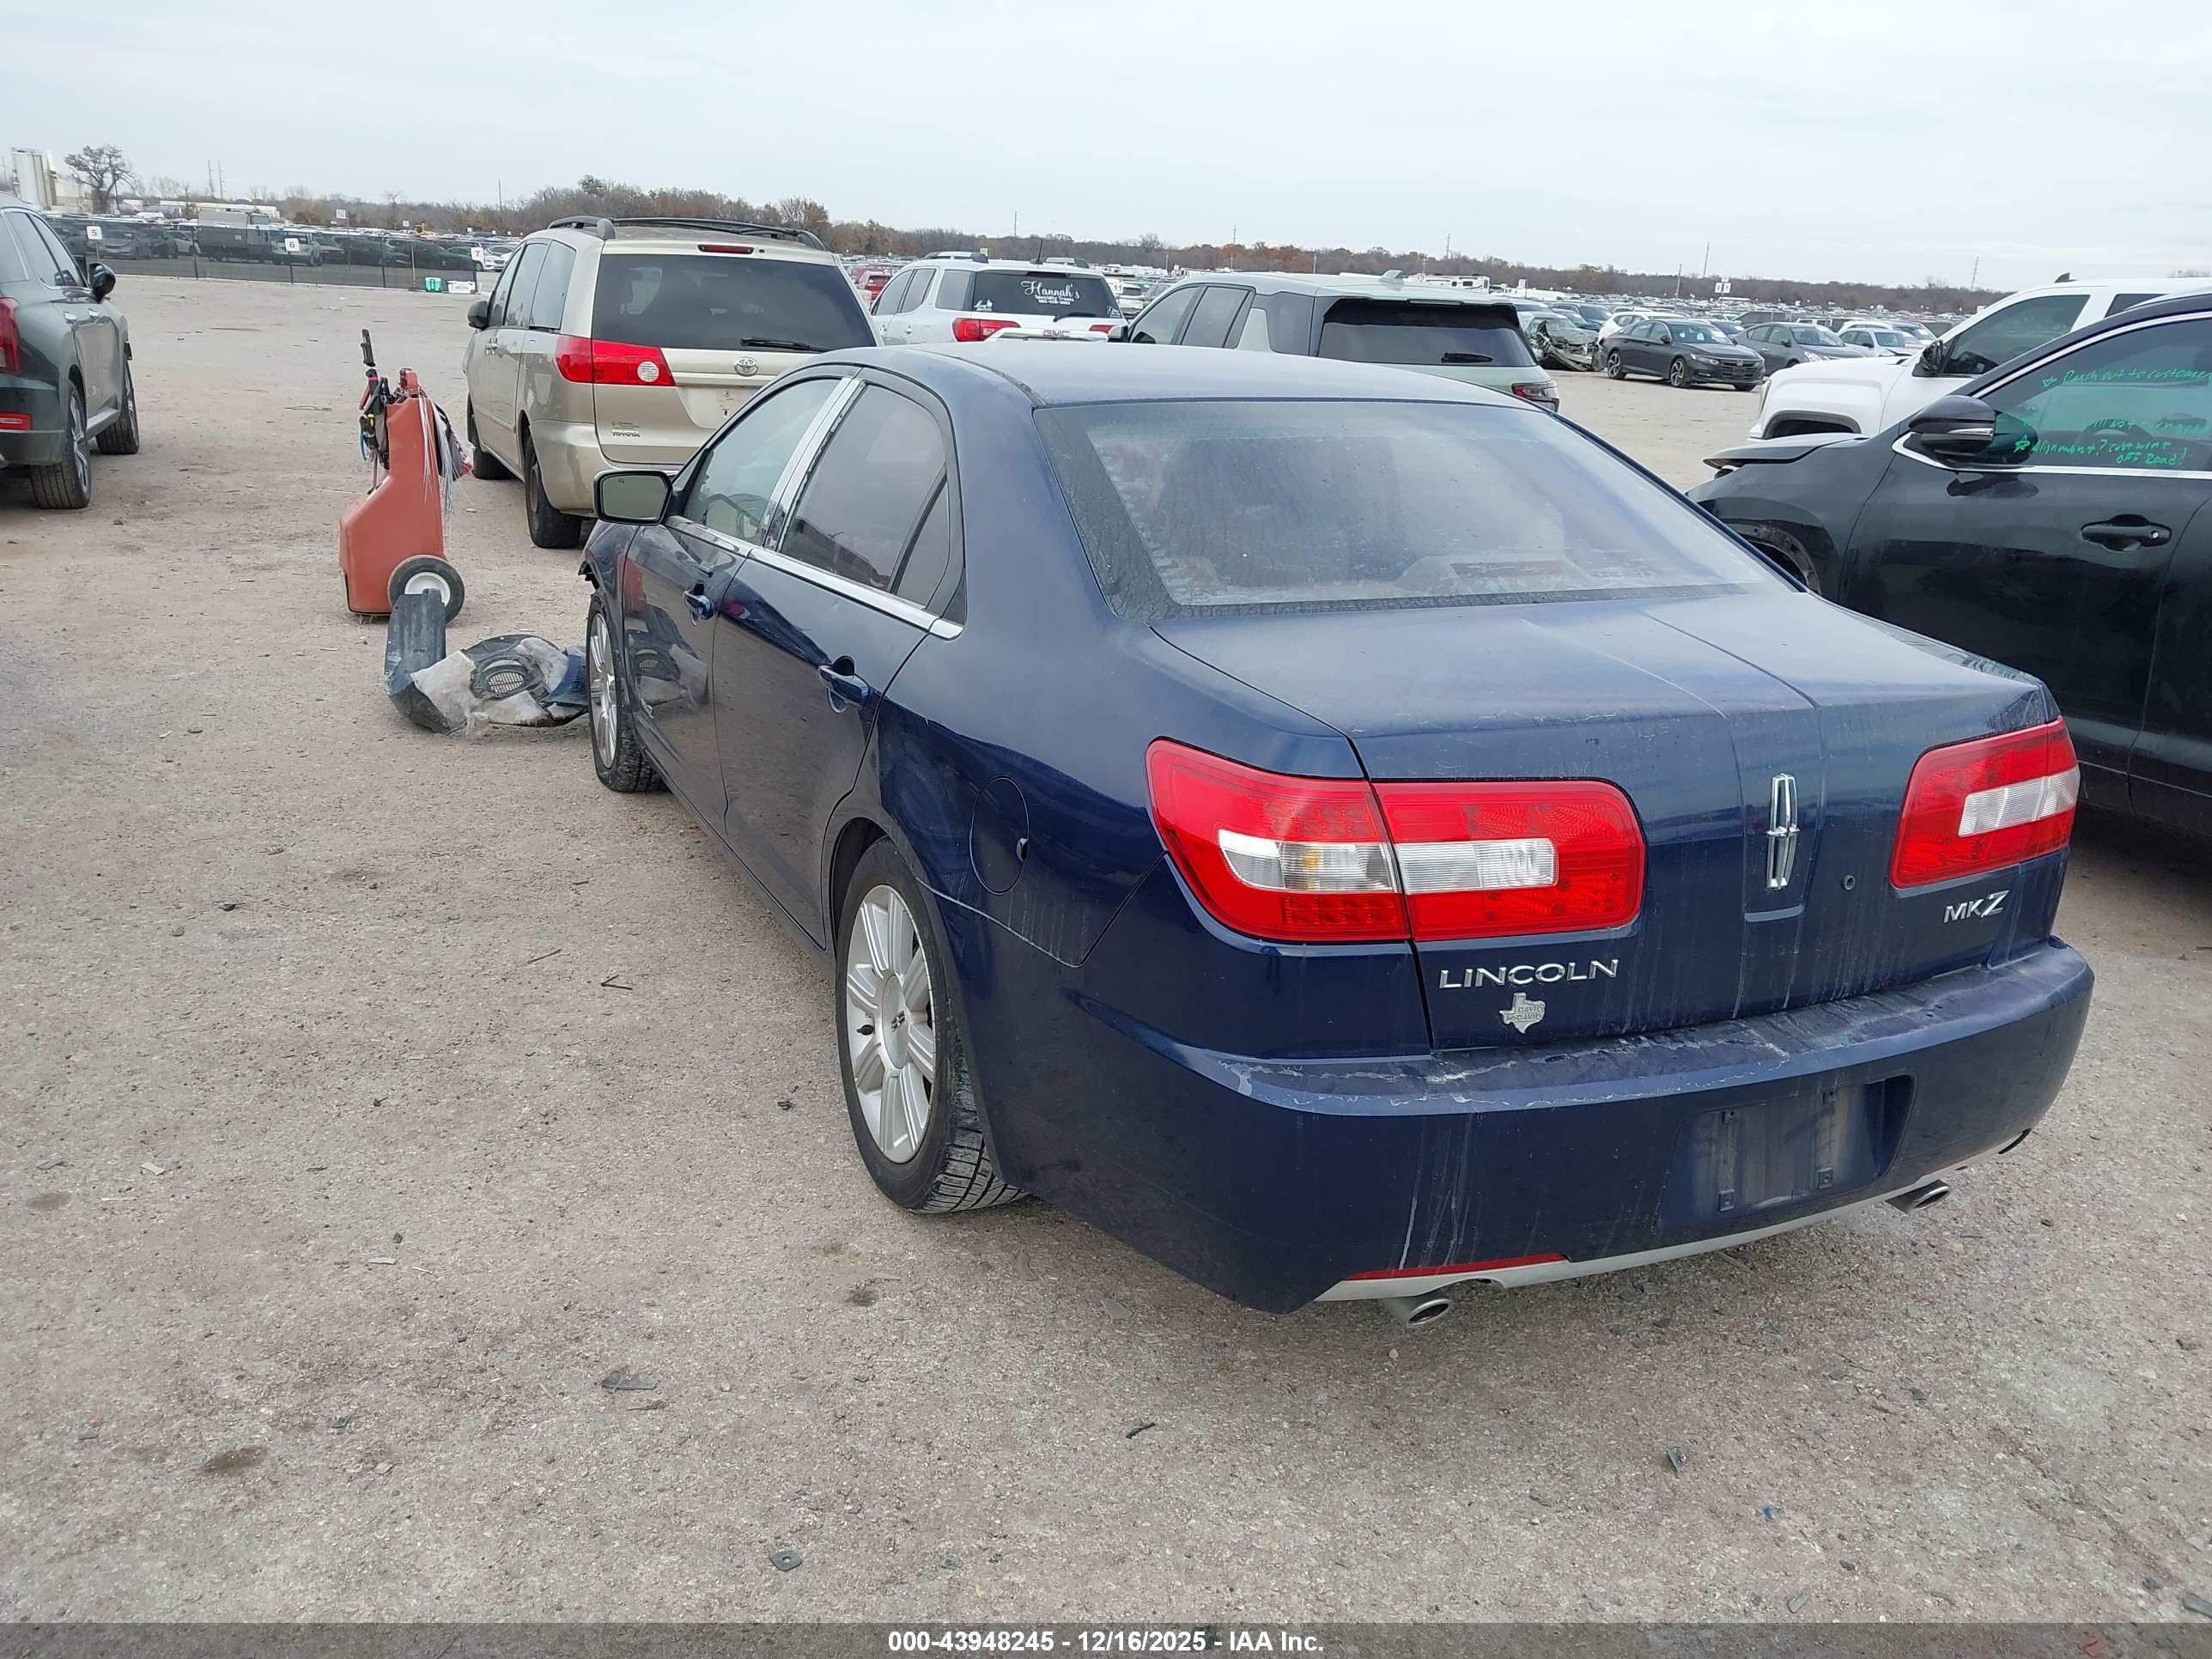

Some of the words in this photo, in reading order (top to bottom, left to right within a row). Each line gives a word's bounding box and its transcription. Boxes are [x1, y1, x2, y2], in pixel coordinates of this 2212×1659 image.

[1020, 281, 1080, 299] Hannah's
[1042, 329, 1070, 337] GMC
[611, 429, 641, 438] TOYOTA
[1943, 890, 2009, 923] MKZ
[1439, 958, 1620, 988] LINCOLN
